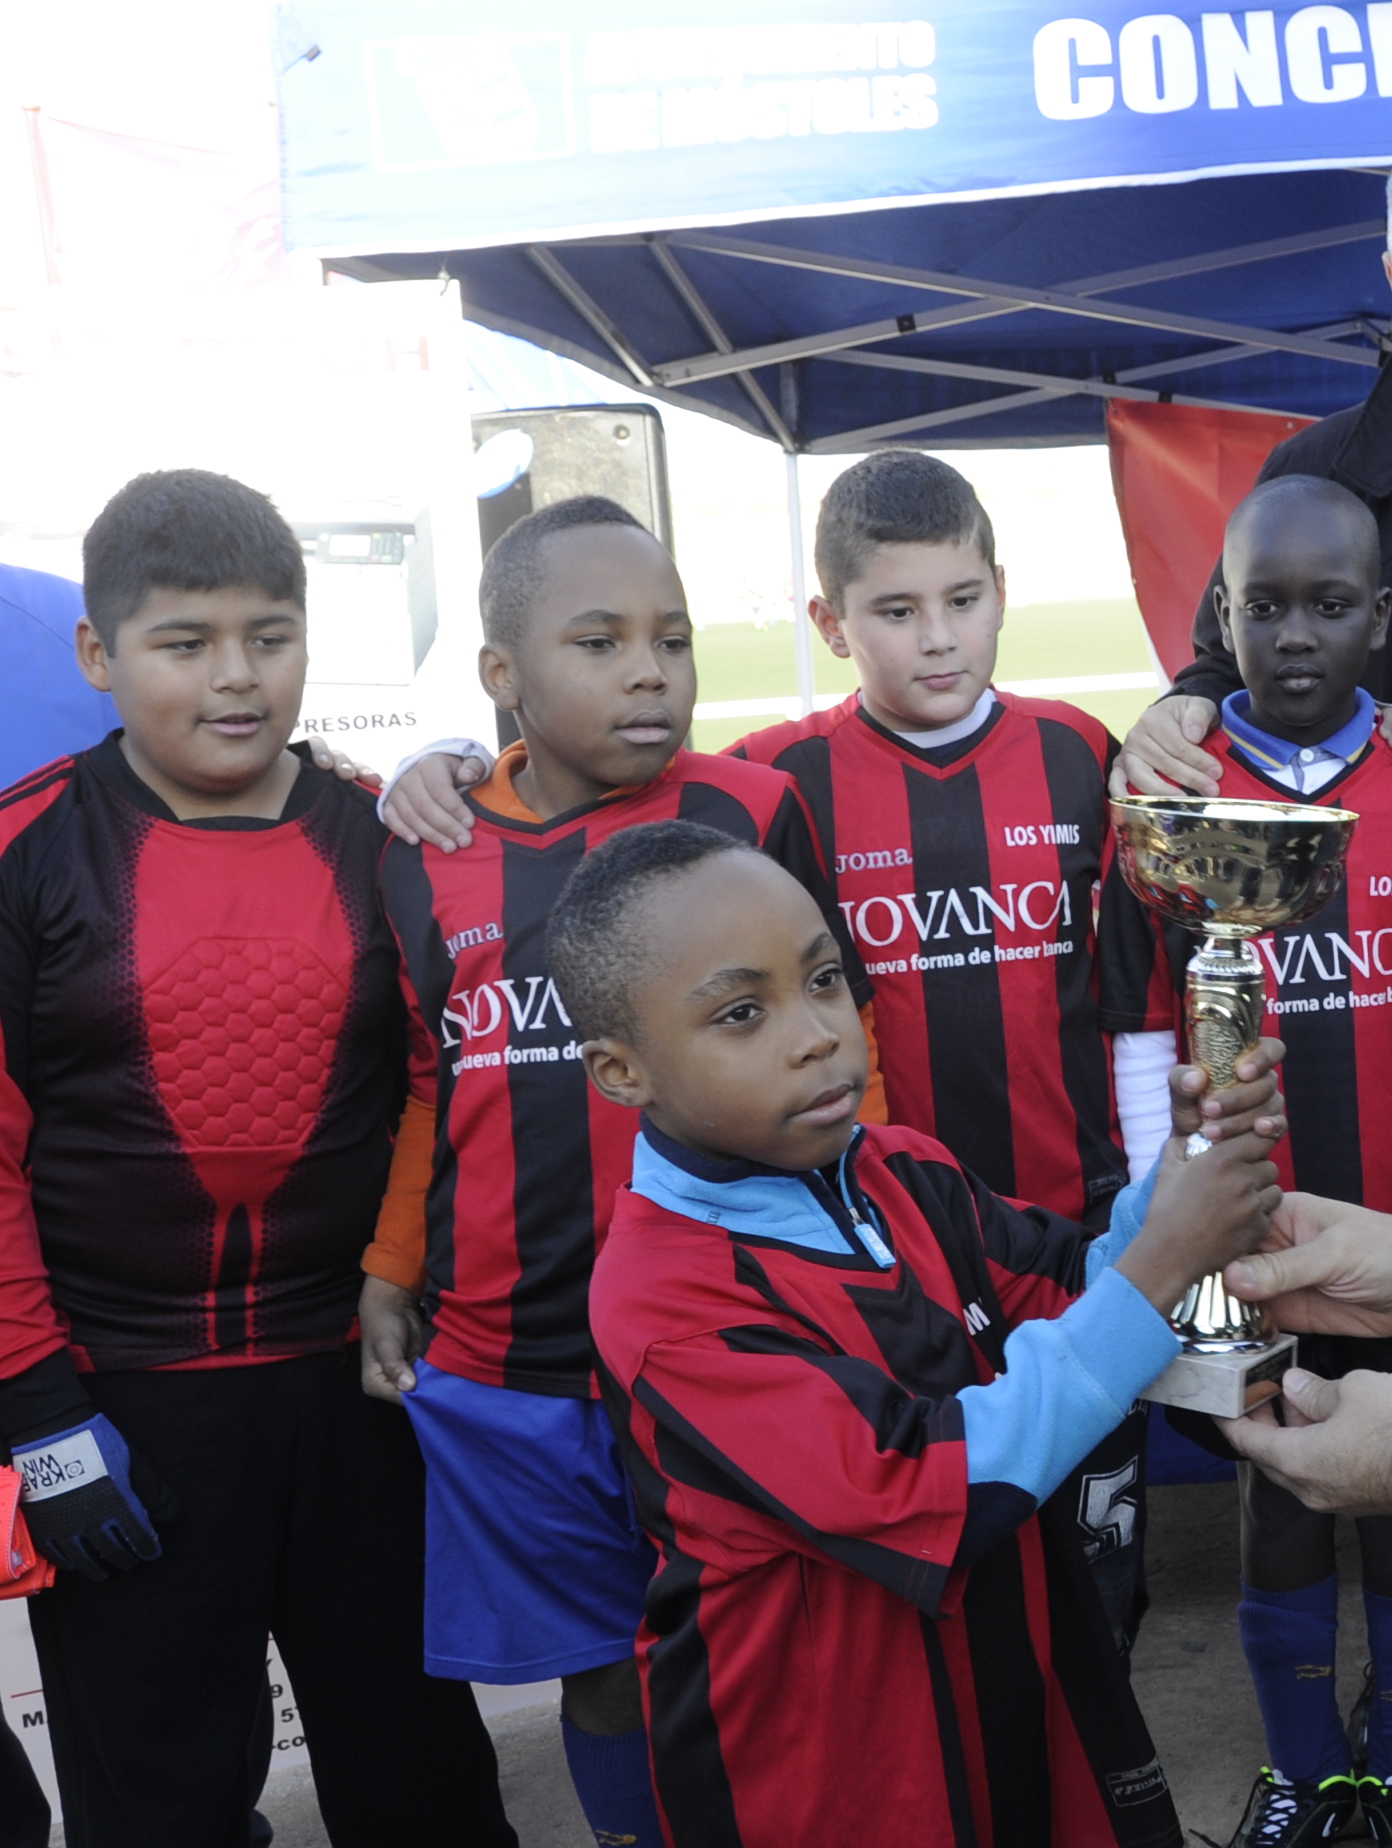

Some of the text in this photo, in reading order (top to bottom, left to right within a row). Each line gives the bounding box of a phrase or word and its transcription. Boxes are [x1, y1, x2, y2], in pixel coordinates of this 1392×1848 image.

[1005, 824, 1080, 847] LOS YIMIS
[865, 958, 907, 975] ueva
[910, 953, 965, 971] forma
[968, 947, 991, 966] de
[994, 944, 1041, 963] hacer
[441, 976, 572, 1048] NOVA
[1266, 997, 1320, 1015] forma
[1323, 992, 1345, 1010] de
[503, 1045, 559, 1065] forma
